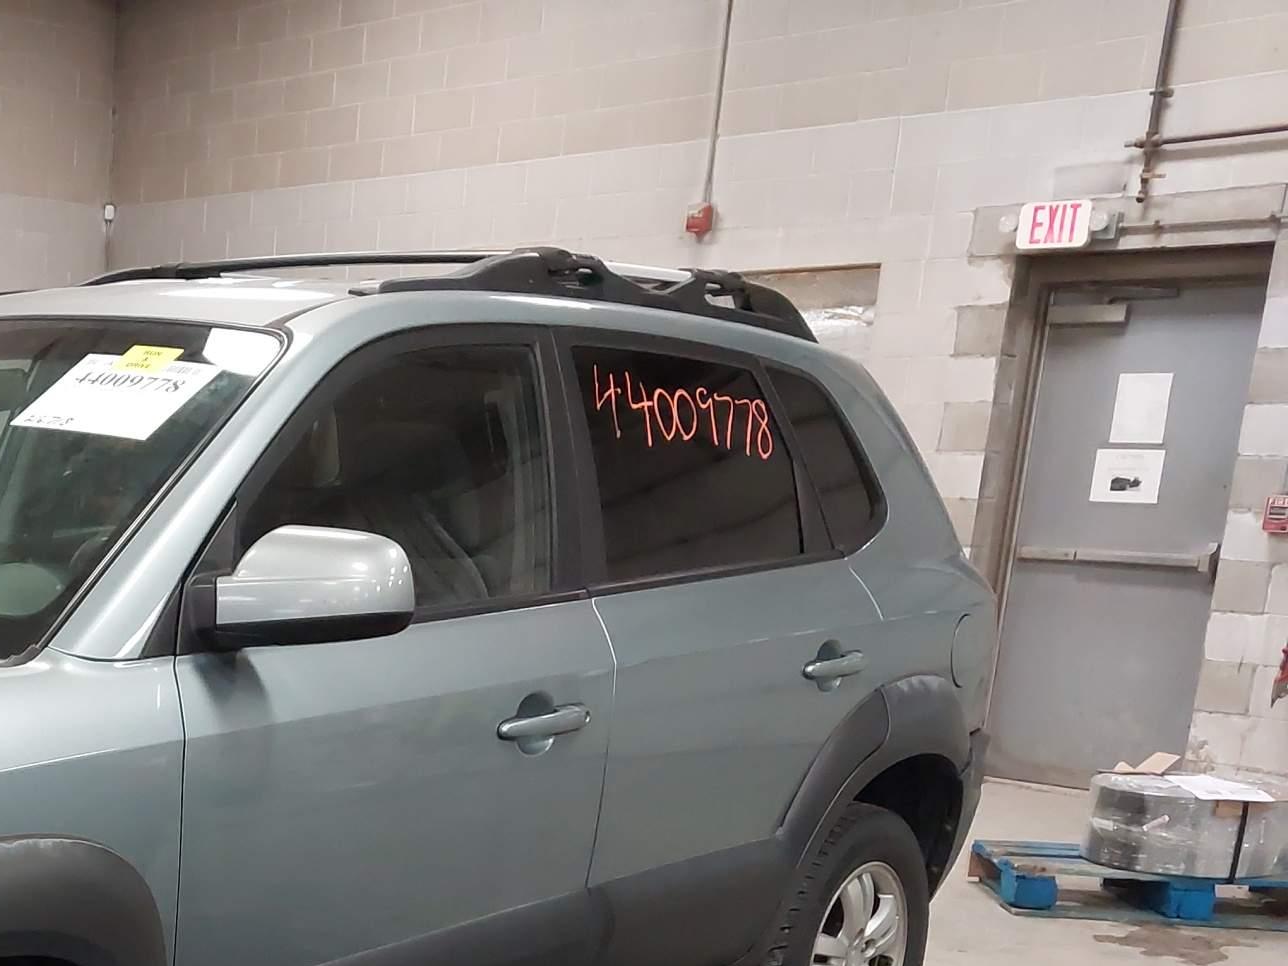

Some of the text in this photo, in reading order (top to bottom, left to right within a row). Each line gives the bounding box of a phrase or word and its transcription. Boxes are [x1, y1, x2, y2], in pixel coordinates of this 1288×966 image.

[1029, 203, 1082, 244] EXIT
[75, 371, 186, 393] 44009778
[594, 363, 774, 460] 44009778
